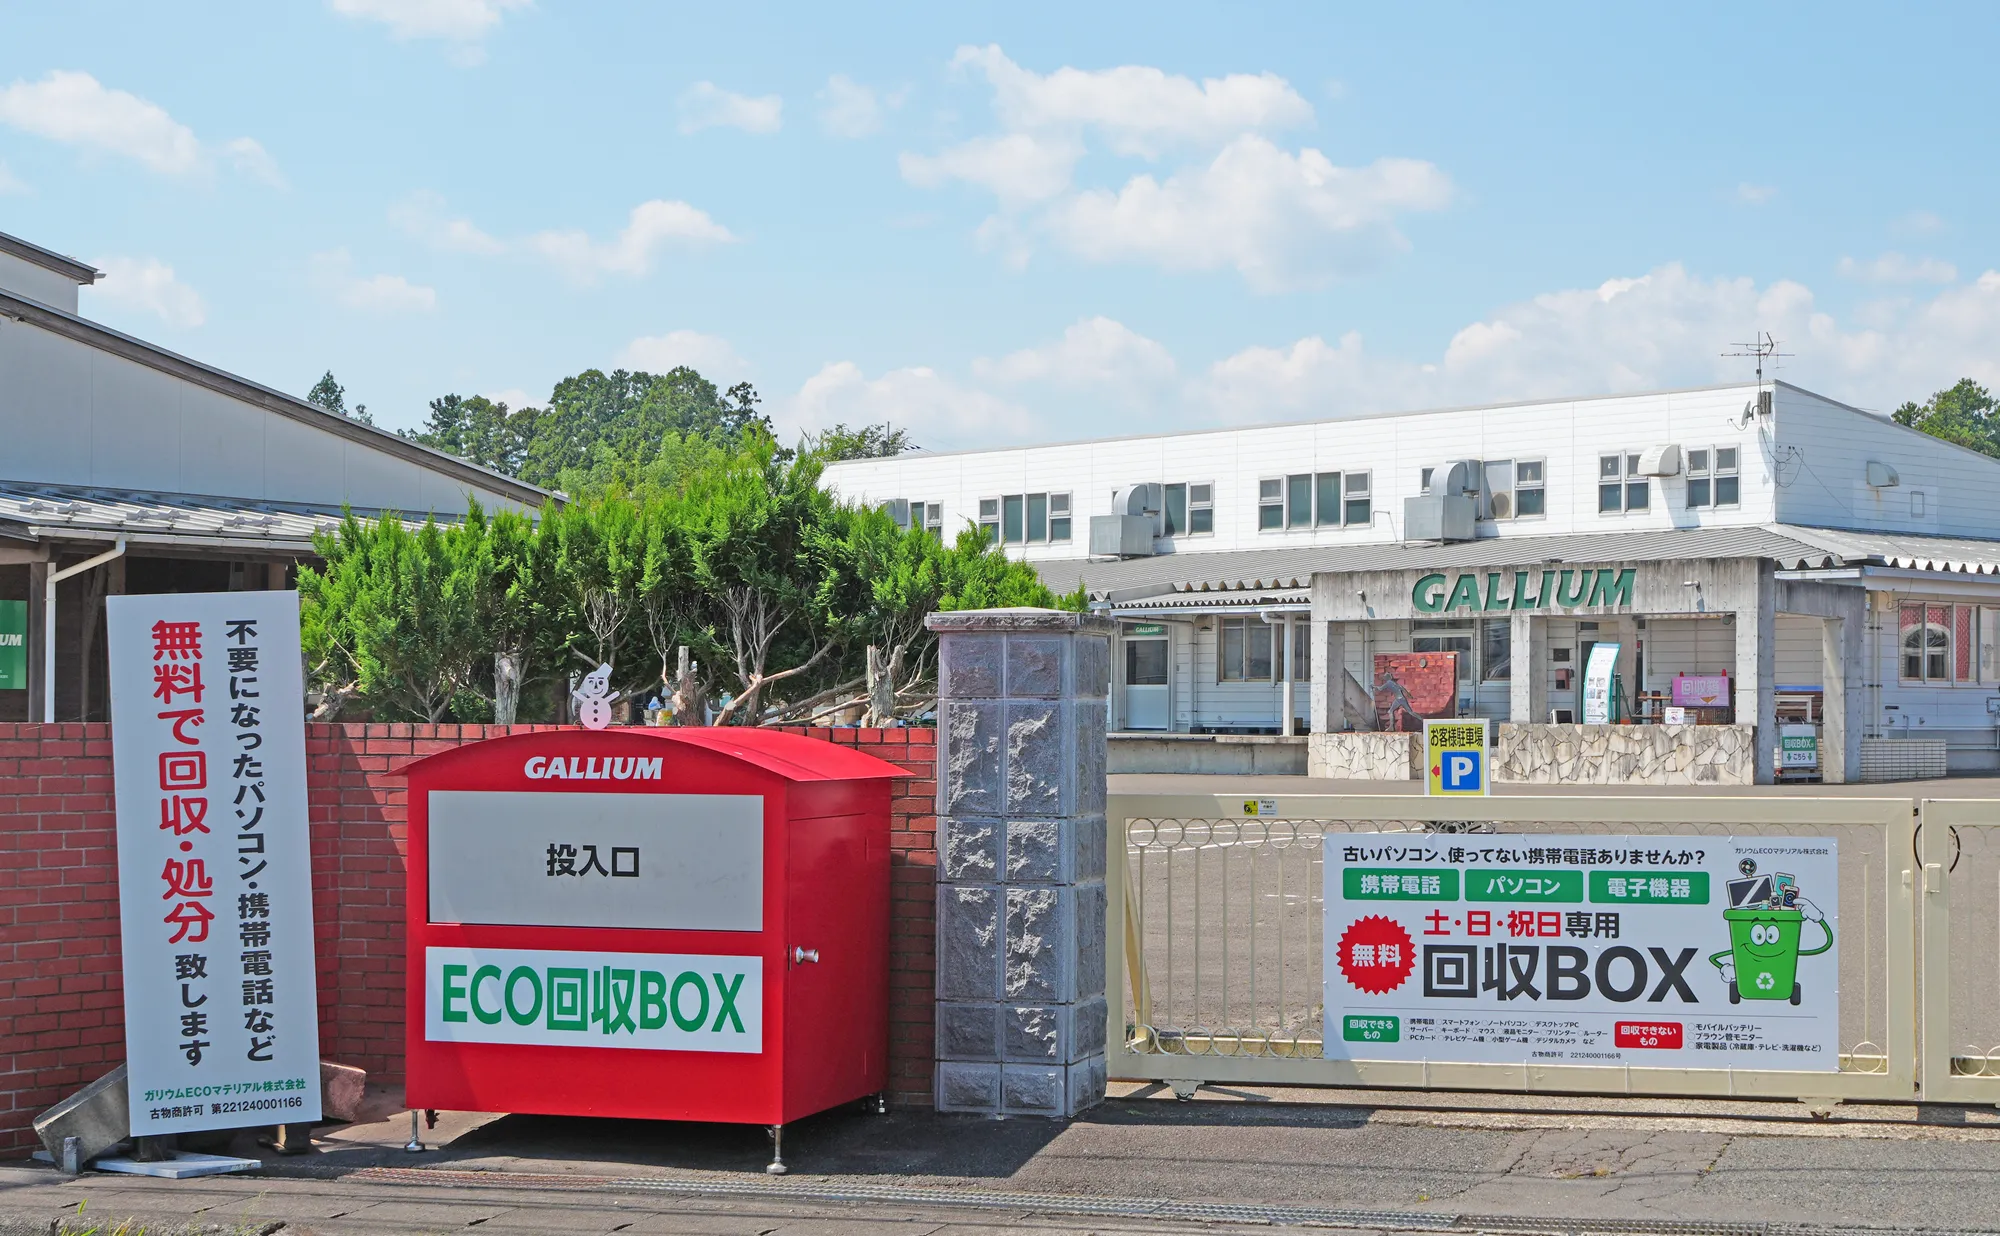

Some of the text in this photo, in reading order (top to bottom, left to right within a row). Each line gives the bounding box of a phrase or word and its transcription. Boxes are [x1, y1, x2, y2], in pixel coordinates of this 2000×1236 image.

[1411, 568, 1637, 613] GALLIUM
[1430, 727, 1484, 748] お客様駐車場
[524, 756, 664, 780] GALLIUM
[1793, 753, 1807, 761] こちら
[1451, 756, 1474, 786] P
[151, 619, 216, 1068] 無料で回収・処分致します
[225, 619, 278, 1063] 不要になったパソコン・携帯電話など
[546, 843, 640, 878] 投入口
[1360, 874, 1441, 895] 携帯電話
[1486, 876, 1561, 895] パソコン
[1607, 878, 1691, 898] 電子機器
[1423, 909, 1620, 939] 土・日・祝日専用
[1352, 944, 1402, 967] 無料
[1423, 942, 1700, 1004] 回収BOX
[442, 964, 746, 1035] ECO回収BOX
[1349, 1019, 1394, 1030] 回収できる
[1363, 1030, 1381, 1040] もの
[1620, 1025, 1677, 1036] 回収できない
[1639, 1037, 1658, 1046] もの
[144, 1078, 307, 1102] ガリウムECOマテリアル株式会社
[149, 1097, 303, 1120] 古物商許可 第221240001166
